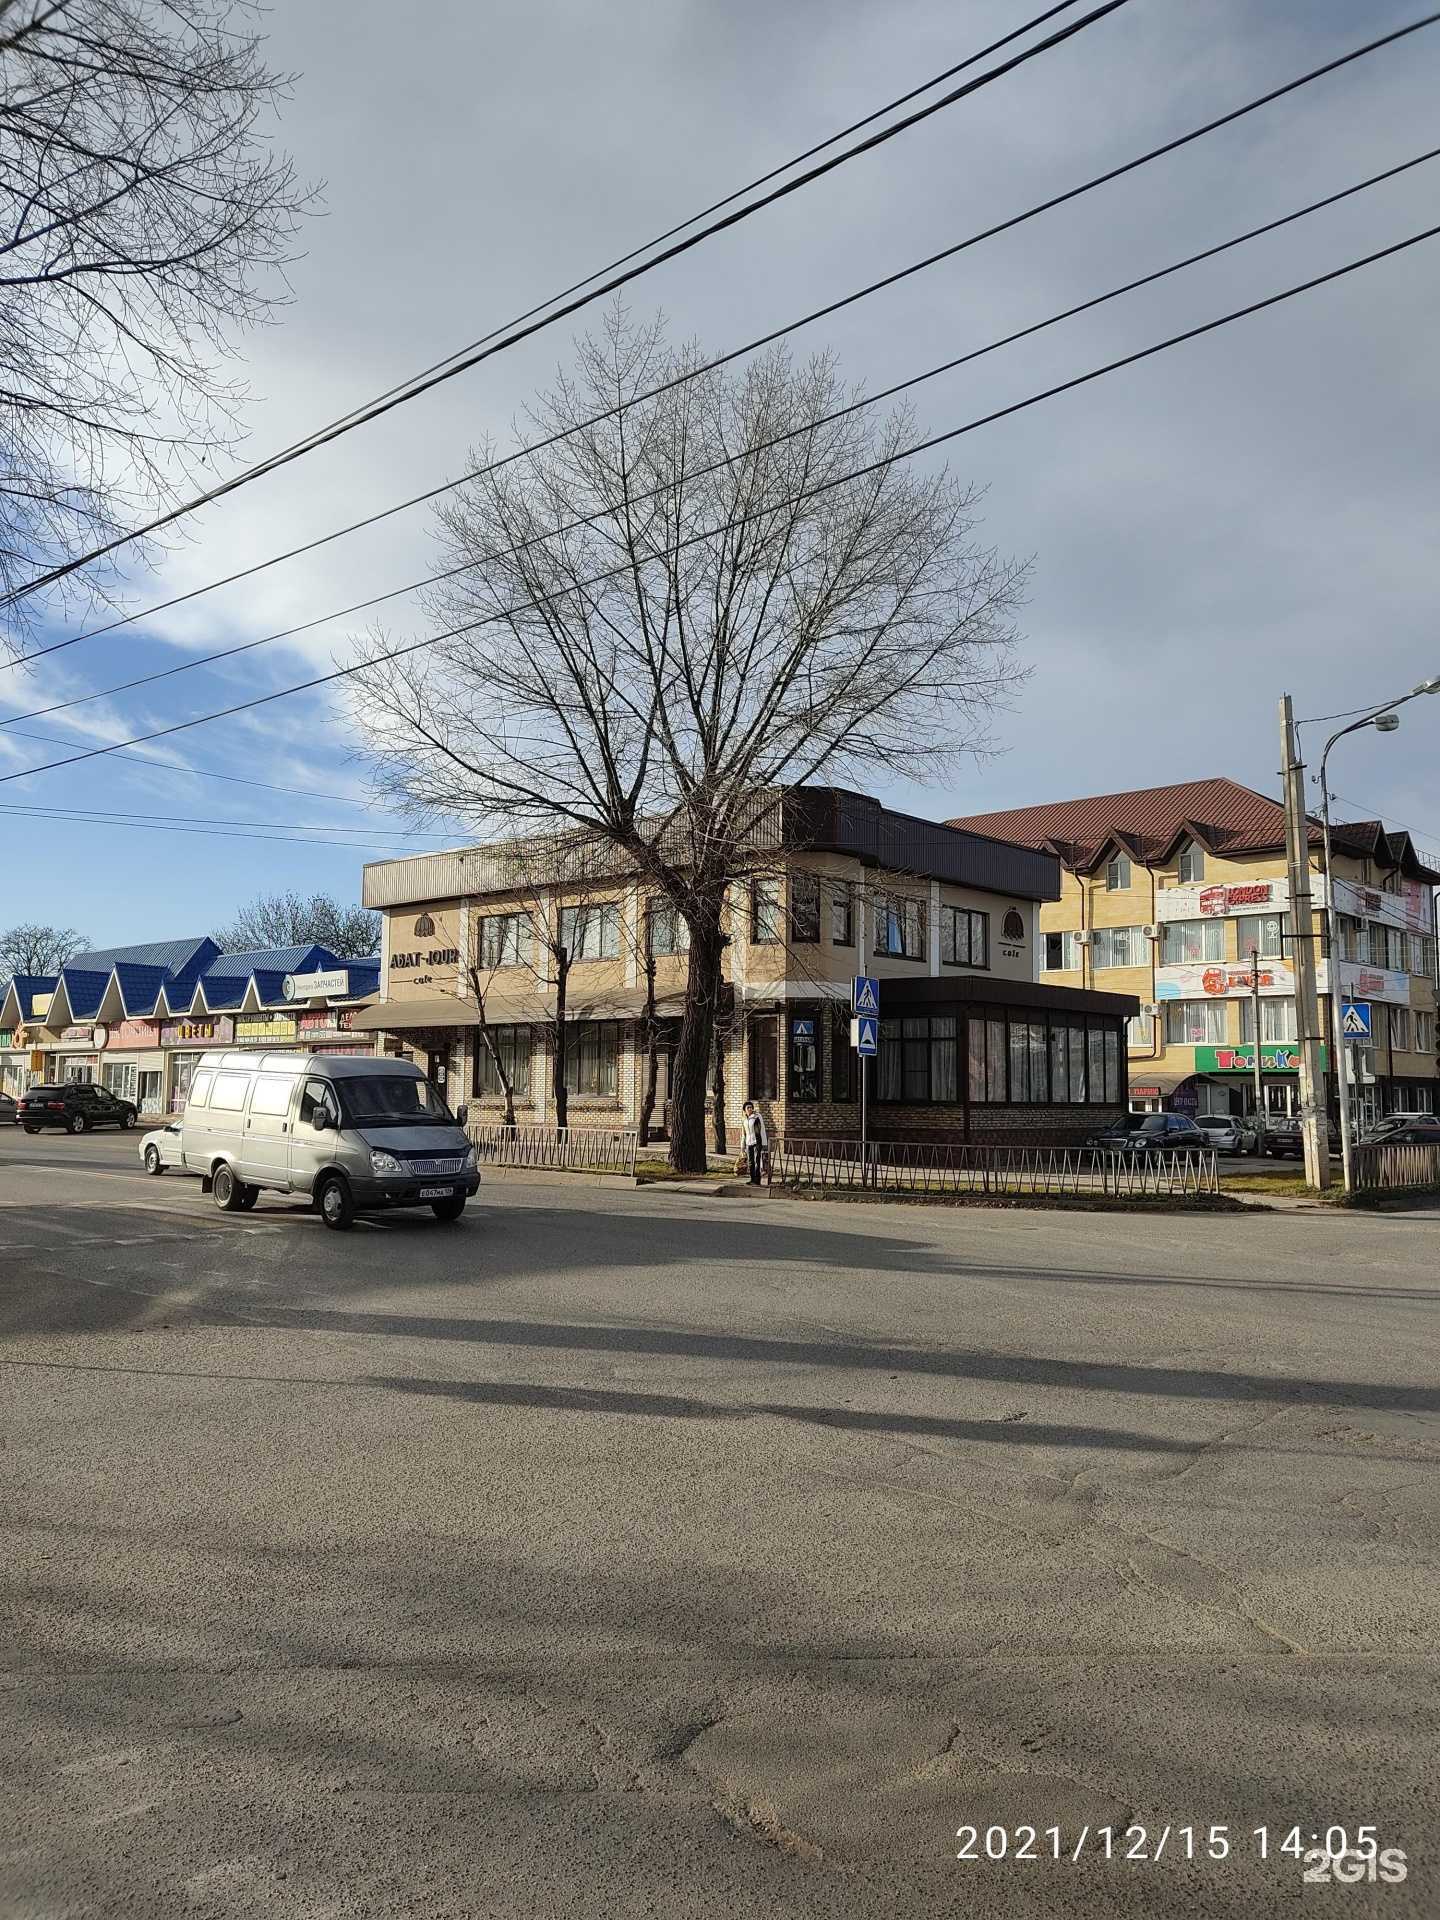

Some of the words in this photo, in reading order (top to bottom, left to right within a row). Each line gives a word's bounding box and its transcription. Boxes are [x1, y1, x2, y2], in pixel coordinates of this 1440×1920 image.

[1228, 884, 1271, 896] LONDON
[390, 948, 460, 969] ABAT-JOUR
[413, 975, 433, 985] cafe
[177, 1023, 214, 1038] ЦВЕТЫ
